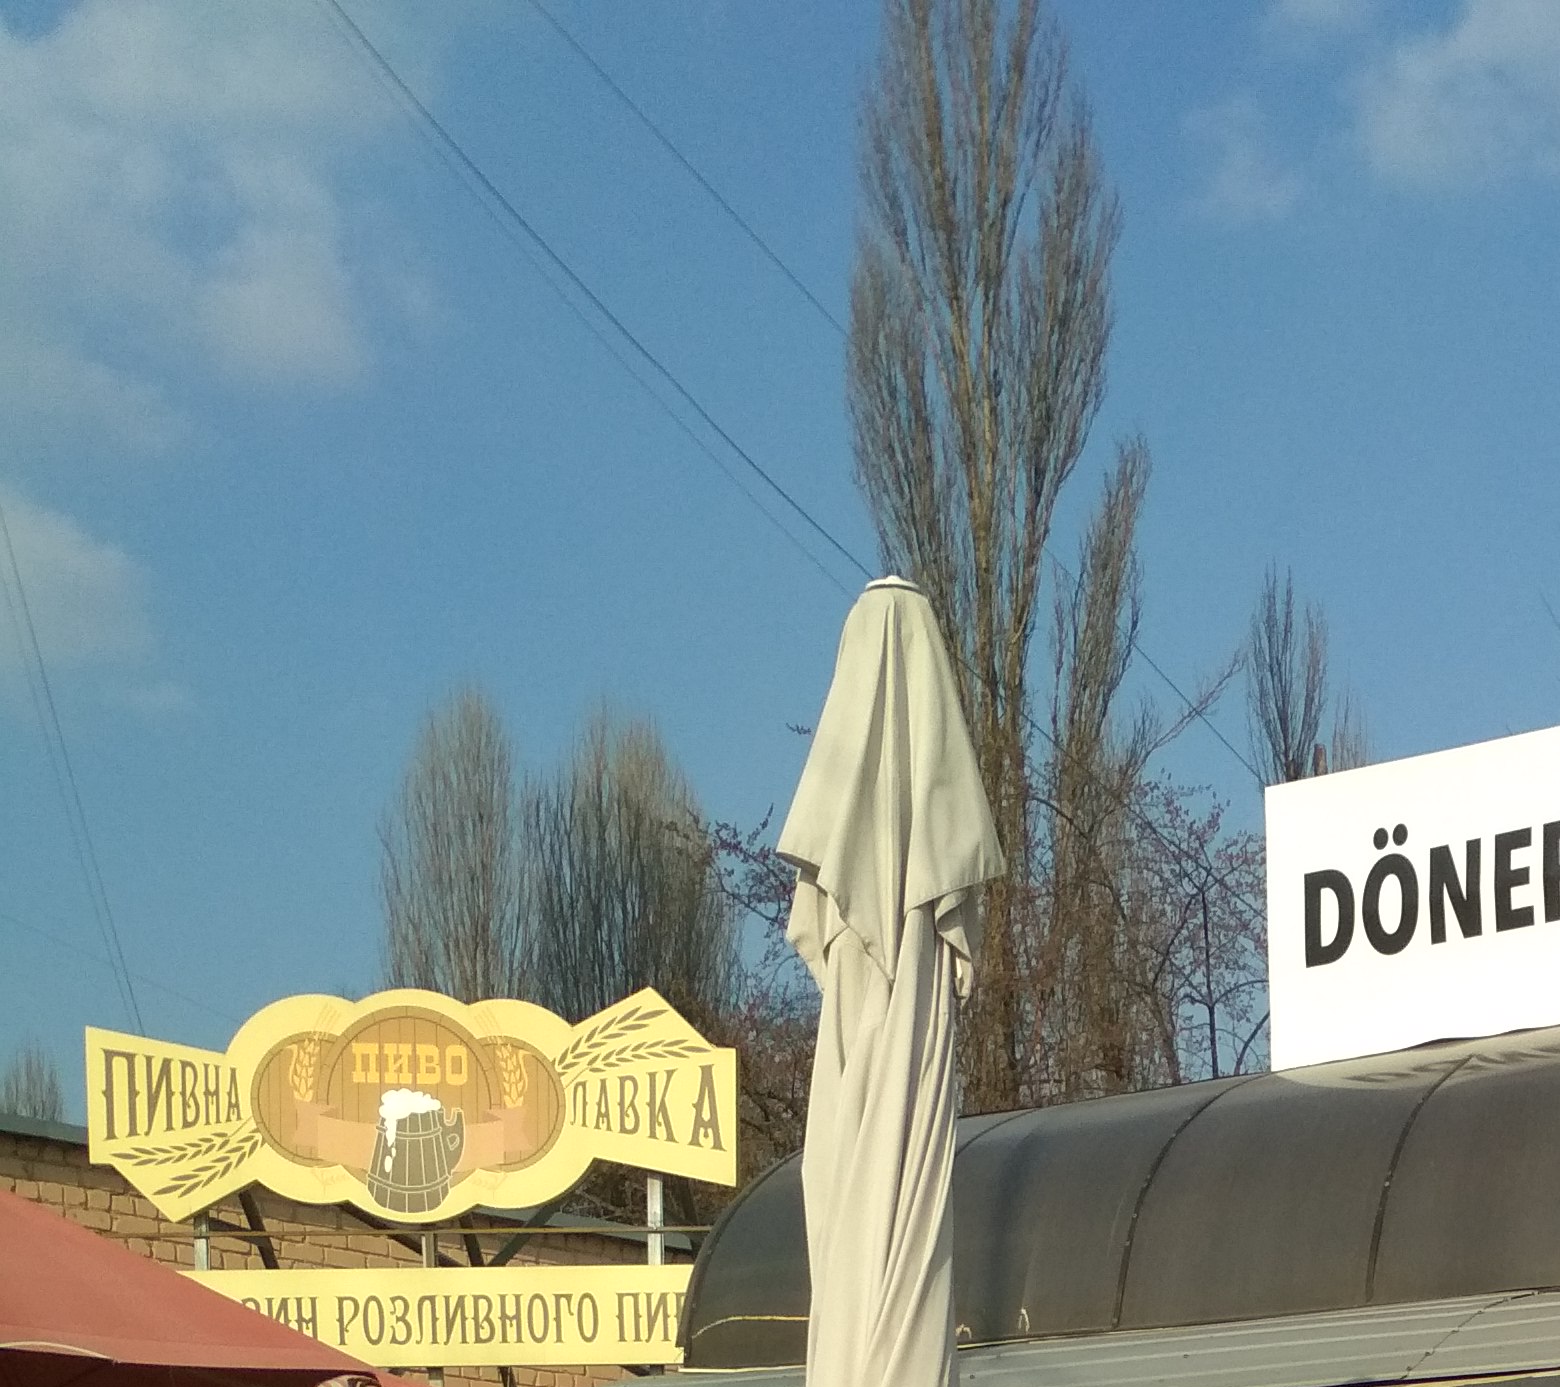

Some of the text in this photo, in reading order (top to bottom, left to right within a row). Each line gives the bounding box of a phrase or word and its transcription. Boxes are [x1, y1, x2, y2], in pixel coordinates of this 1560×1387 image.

[352, 1042, 468, 1085] ПИВО
[101, 1048, 727, 1152] ПИВНА ЛАВКА
[336, 1292, 598, 1346] РОЗЛИВНОГО
